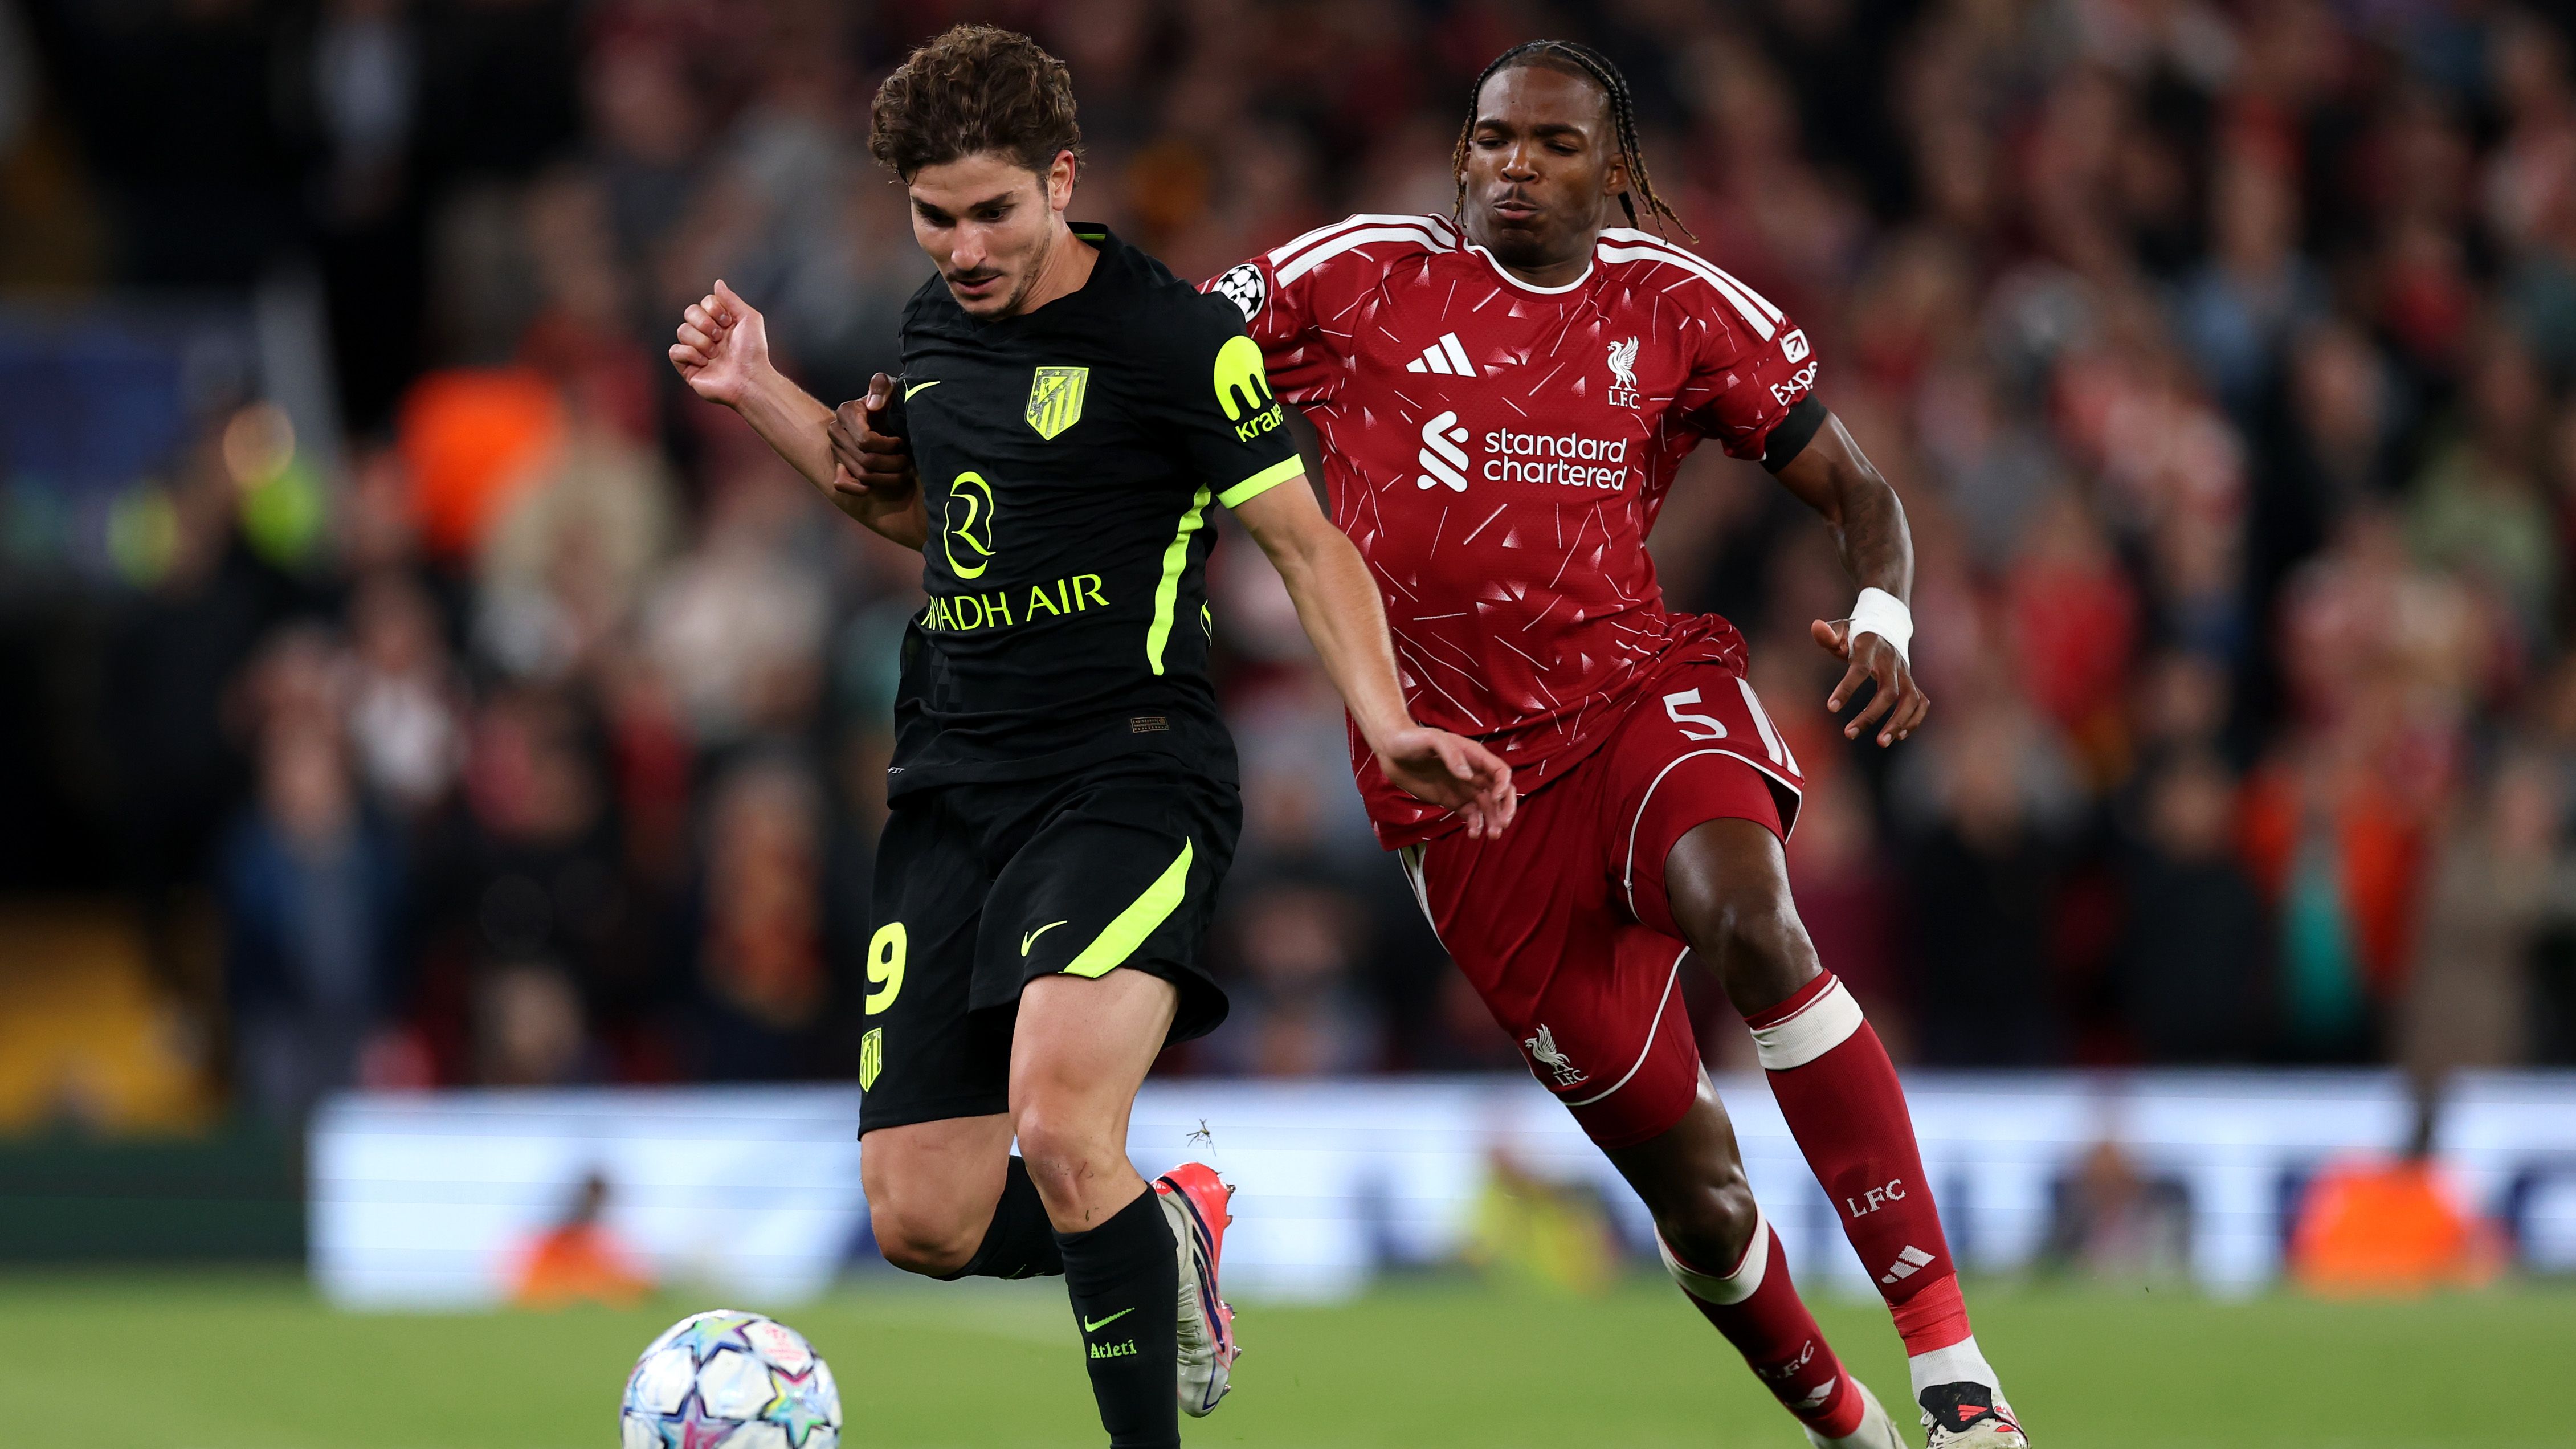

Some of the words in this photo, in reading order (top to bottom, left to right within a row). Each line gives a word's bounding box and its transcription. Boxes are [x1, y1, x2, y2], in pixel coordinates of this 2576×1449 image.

[1484, 427, 1627, 463] standard
[1483, 455, 1628, 491] chartered
[1026, 574, 1110, 622] AIR
[1662, 687, 1728, 741] 5
[865, 921, 907, 1015] 9
[1846, 1178, 1907, 1218] LFC
